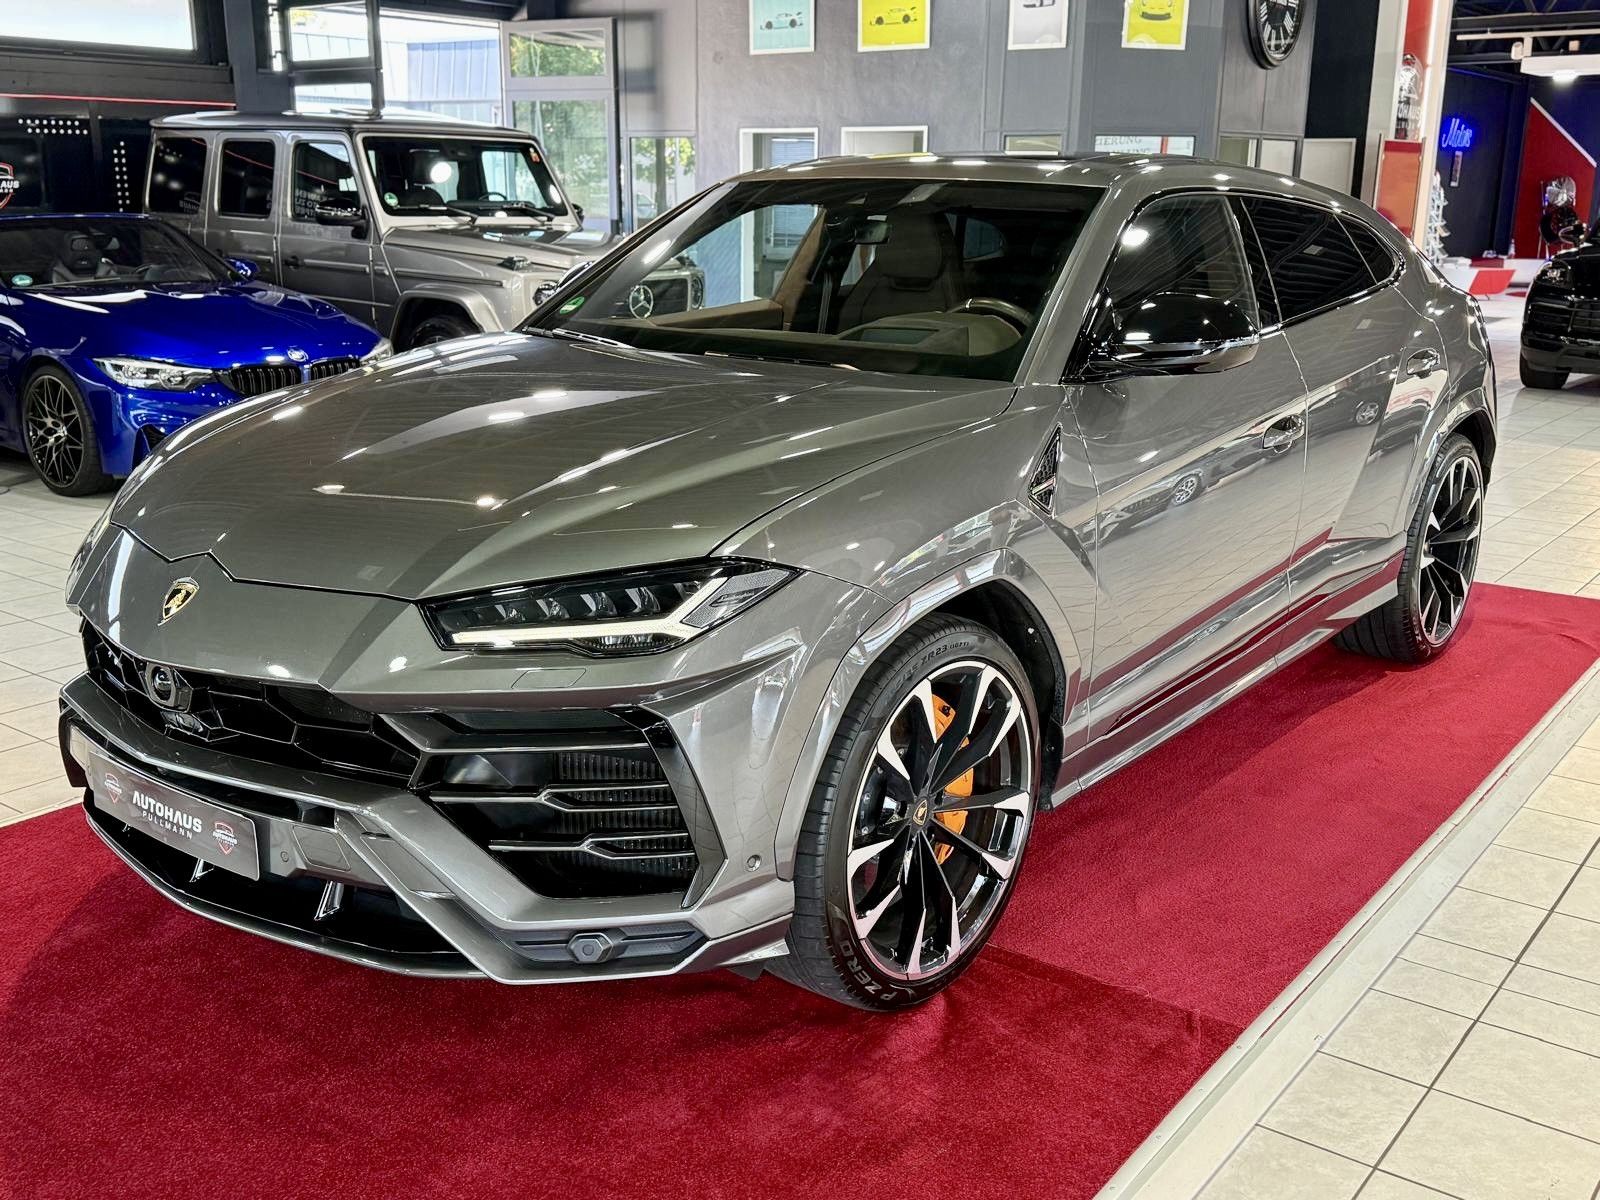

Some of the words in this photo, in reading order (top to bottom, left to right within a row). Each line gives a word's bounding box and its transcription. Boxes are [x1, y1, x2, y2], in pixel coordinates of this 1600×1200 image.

[132, 790, 202, 832] AUTOHAUS
[142, 811, 193, 840] PULLMANN
[840, 940, 883, 994] ZERO
